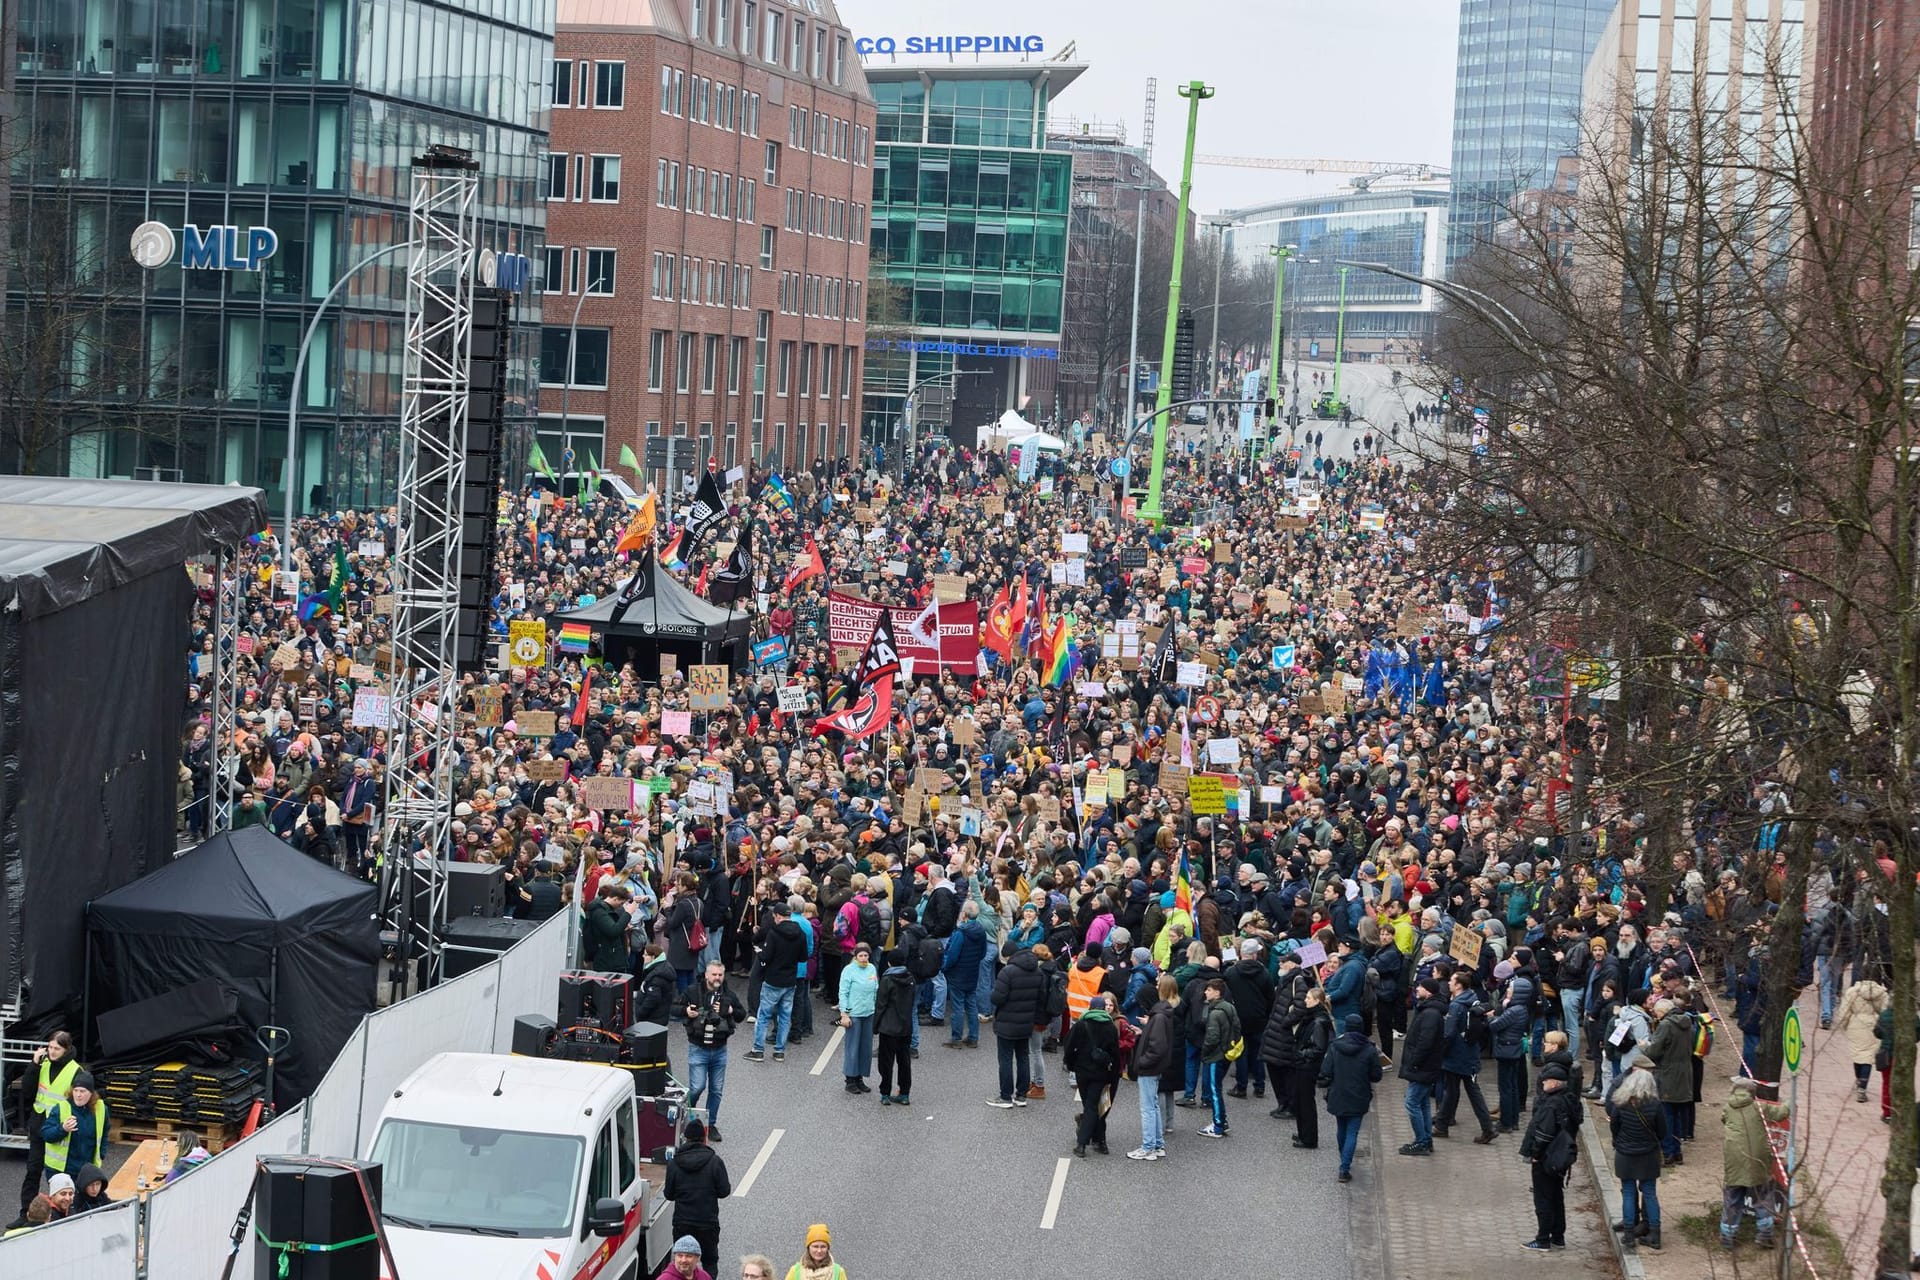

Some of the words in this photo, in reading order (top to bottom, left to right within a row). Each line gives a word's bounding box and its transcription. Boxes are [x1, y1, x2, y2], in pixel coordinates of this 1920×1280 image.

[906, 35, 1044, 54] SHIPPING
[181, 223, 279, 272] MLP
[986, 345, 1058, 361] EUROPE
[831, 603, 893, 620] GEMEINS
[658, 623, 697, 634] PROTONES
[832, 631, 853, 641] UND
[475, 698, 501, 706] NAZIS
